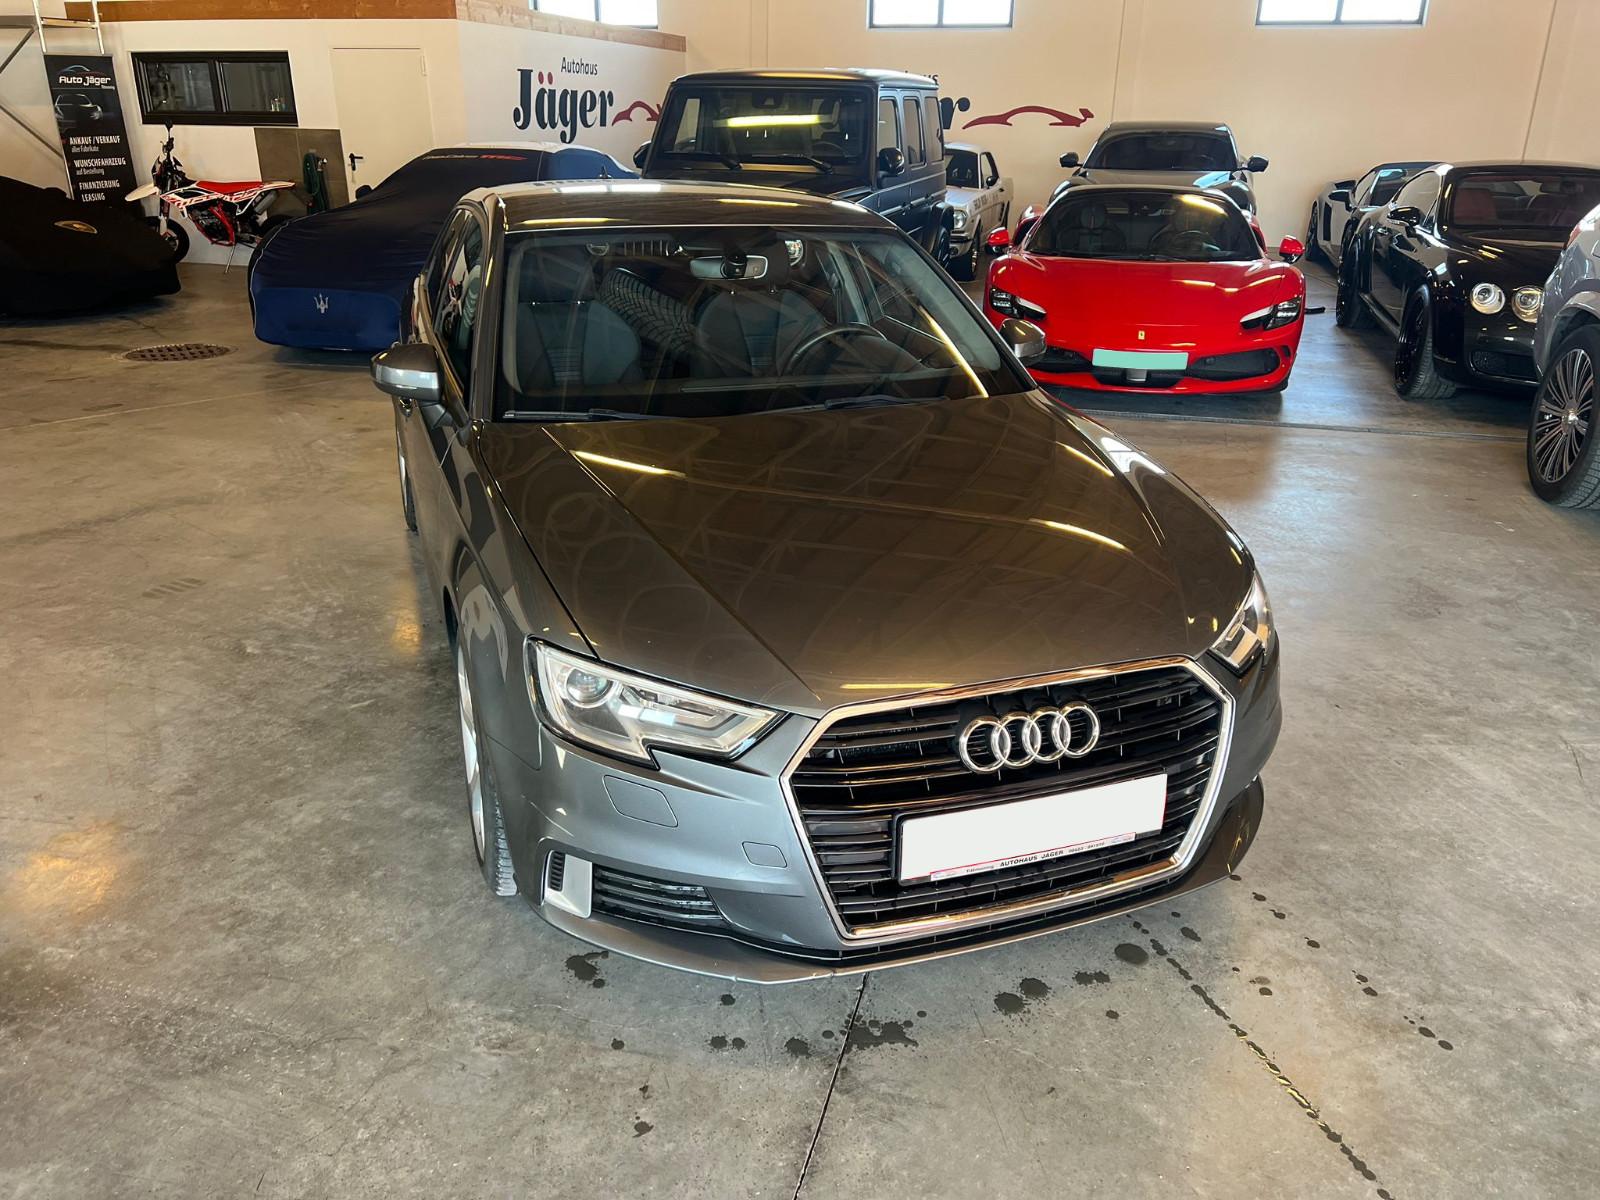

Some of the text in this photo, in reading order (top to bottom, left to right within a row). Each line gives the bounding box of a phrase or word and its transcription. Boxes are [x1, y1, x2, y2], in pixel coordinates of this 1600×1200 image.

[561, 57, 598, 76] Autohaus
[59, 76, 111, 86] Auto Jäger
[513, 68, 614, 144] Jäger
[69, 136, 92, 145] ANKAUF
[95, 135, 120, 144] VERKAUF
[74, 157, 126, 168] WUNSCHFAHRZEUG
[79, 180, 120, 190] FINANZIERUNG
[82, 193, 105, 202] LEASING
[1000, 855, 1037, 867] AUTOHAUS
